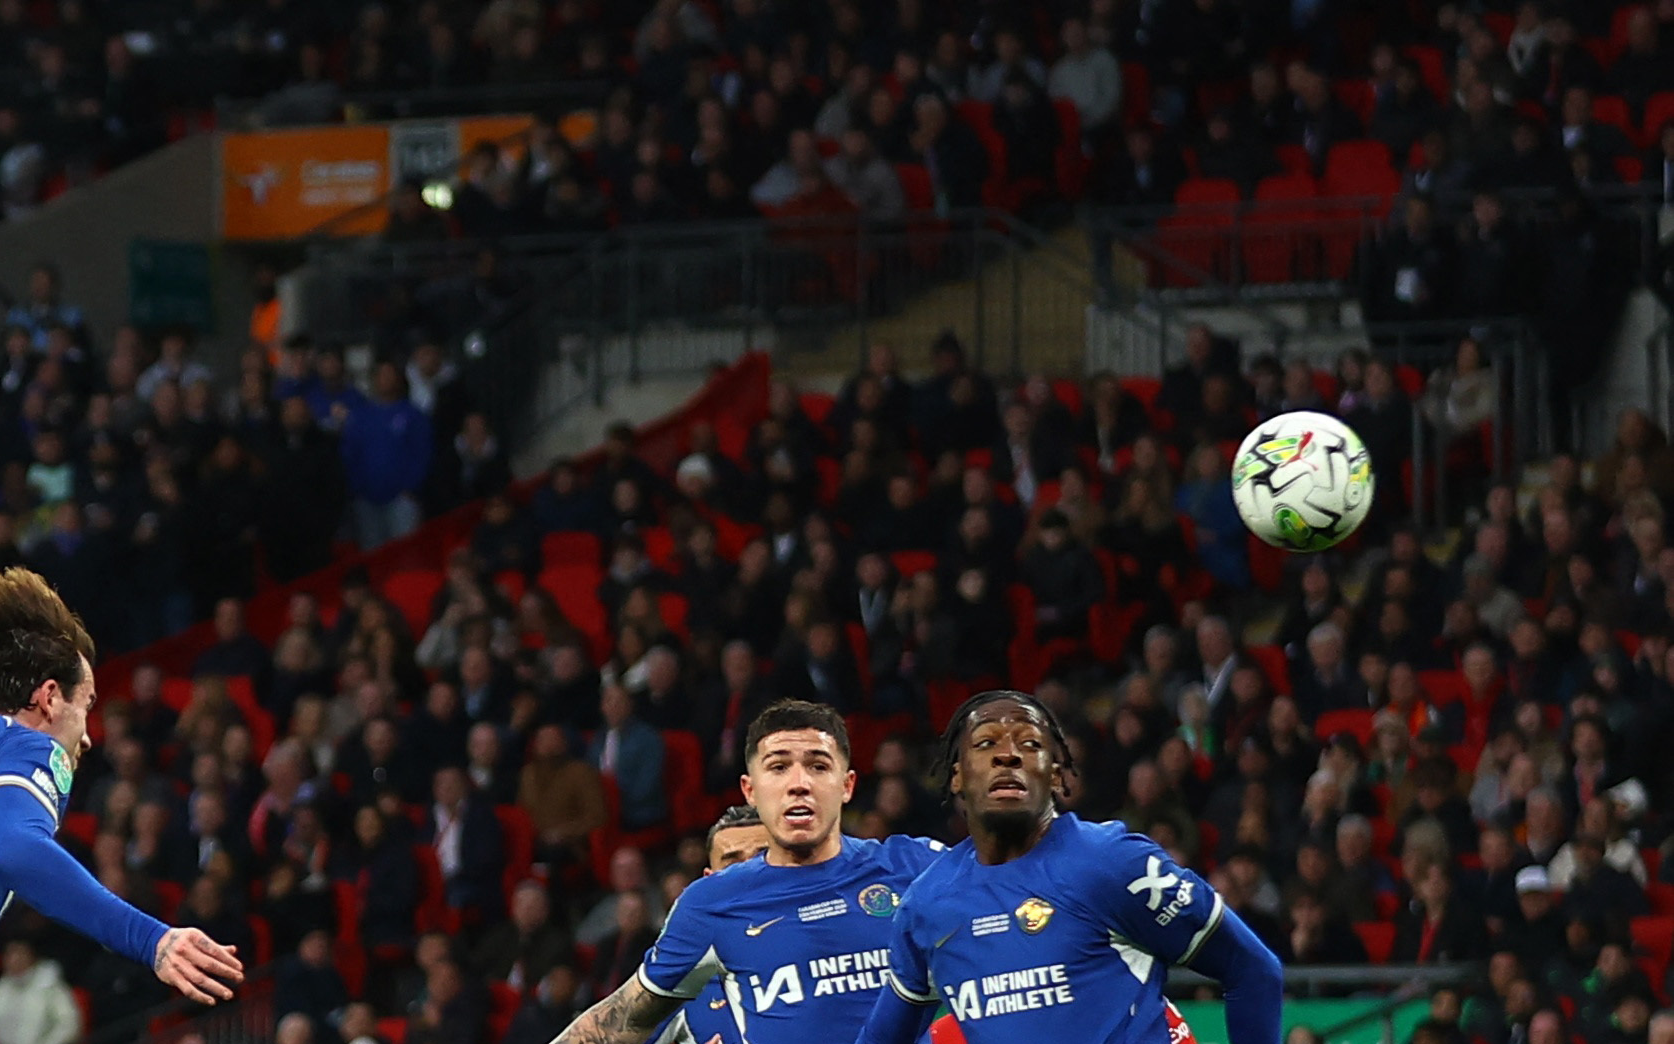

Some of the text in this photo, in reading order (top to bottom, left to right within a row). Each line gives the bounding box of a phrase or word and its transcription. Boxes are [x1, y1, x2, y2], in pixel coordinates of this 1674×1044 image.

[809, 948, 891, 978] INFINI
[982, 964, 1068, 995] INFINITE
[985, 984, 1075, 1017] ATHLETE
